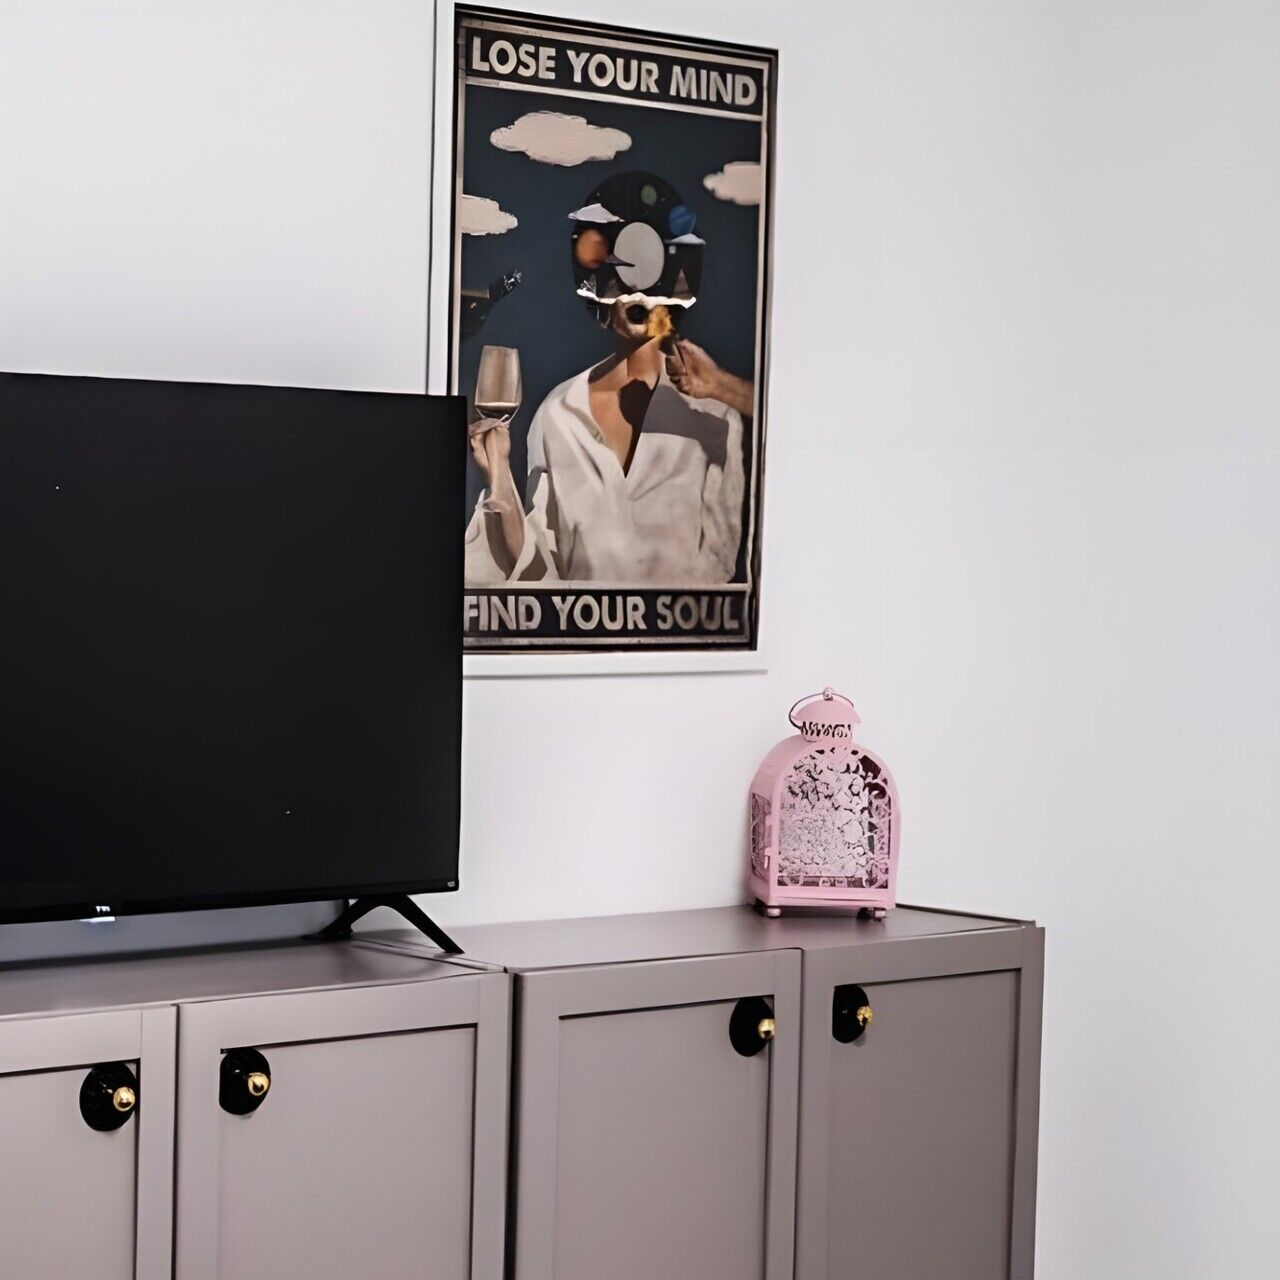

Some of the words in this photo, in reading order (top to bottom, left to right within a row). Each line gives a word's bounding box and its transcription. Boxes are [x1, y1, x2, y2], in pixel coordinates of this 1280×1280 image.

[471, 35, 557, 81] LOSE
[566, 48, 661, 95] YOUR
[669, 64, 758, 107] MIND
[463, 594, 543, 632] FIND
[551, 594, 649, 631] YOUR
[656, 594, 741, 631] SOUL
